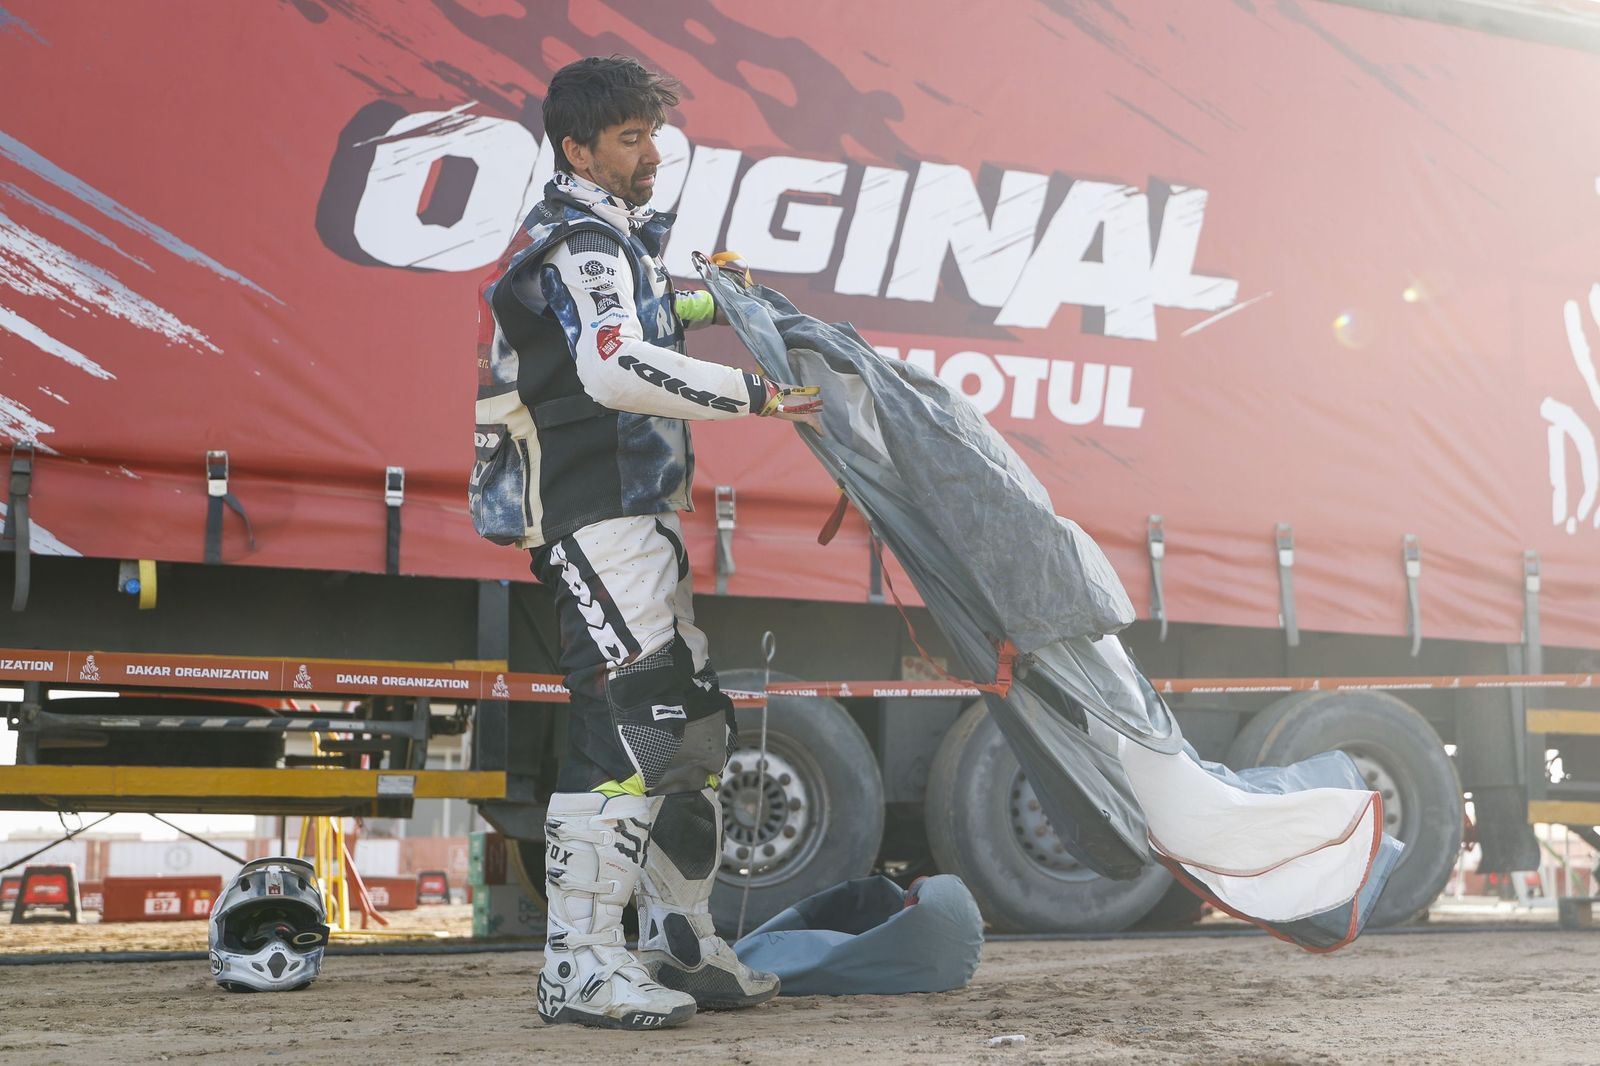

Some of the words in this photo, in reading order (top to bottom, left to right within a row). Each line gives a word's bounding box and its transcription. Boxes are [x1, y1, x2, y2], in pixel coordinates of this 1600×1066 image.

[126, 664, 170, 677] DAKAR
[175, 667, 269, 680] ORGANIZATION
[336, 673, 378, 686] DAKAR
[382, 675, 469, 689] ORGANIZATION
[873, 688, 908, 697] DAKAR
[546, 839, 574, 866] FOX
[631, 1014, 666, 1027] FOX
